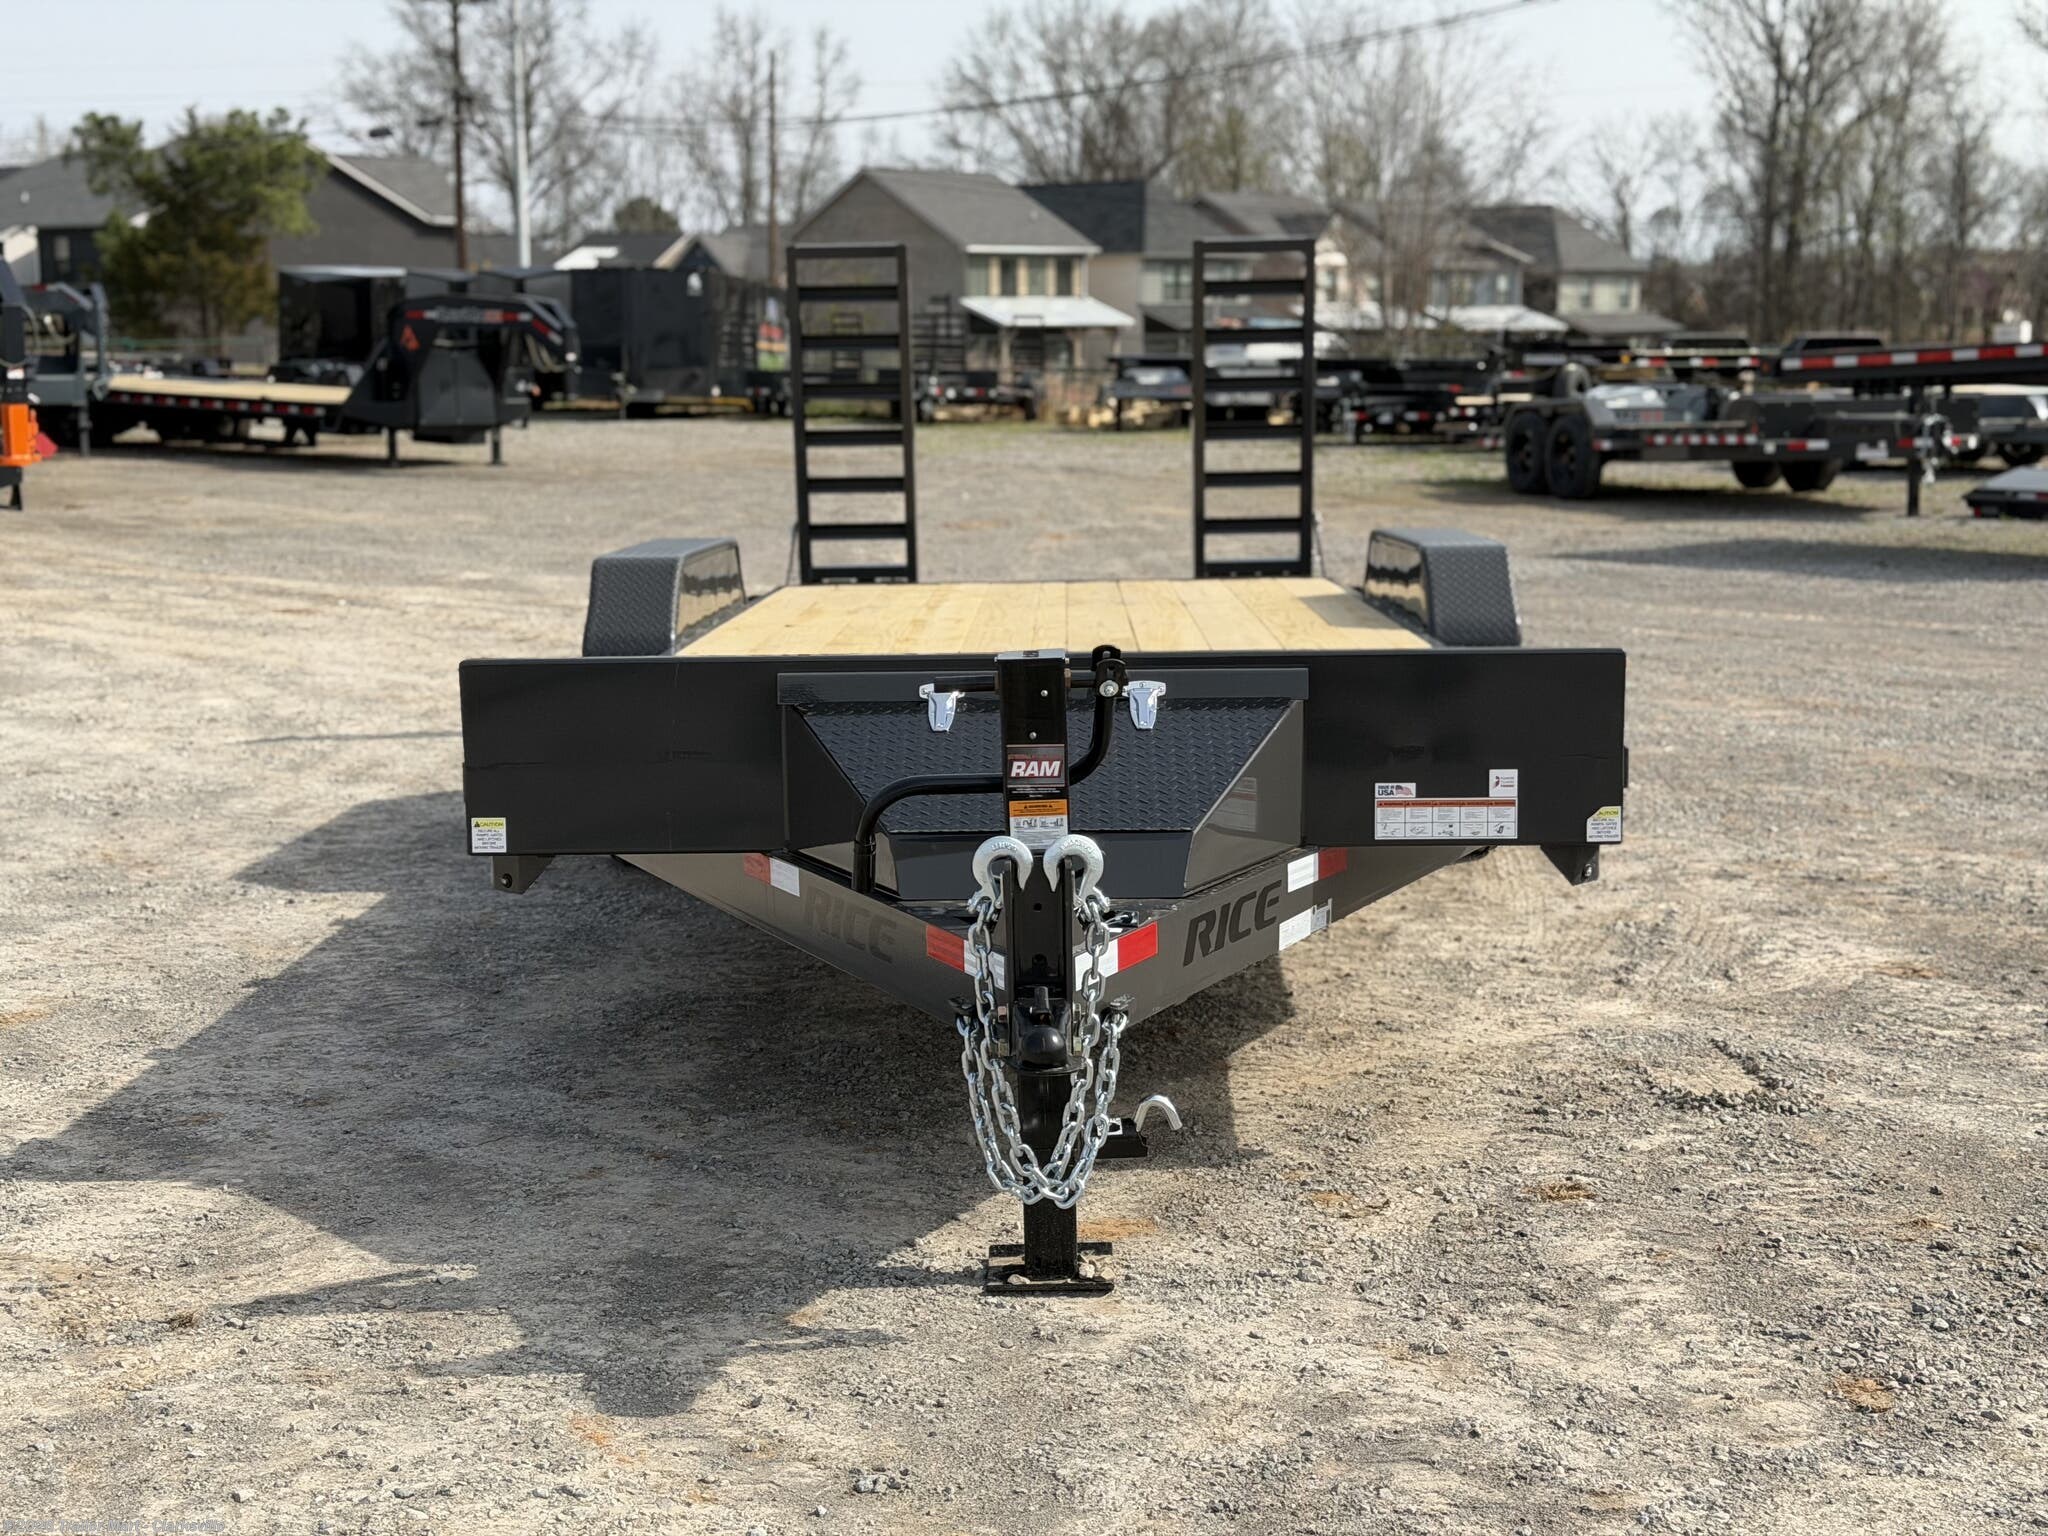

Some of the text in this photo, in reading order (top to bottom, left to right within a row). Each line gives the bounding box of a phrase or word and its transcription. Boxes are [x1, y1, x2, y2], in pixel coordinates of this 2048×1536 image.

[1011, 761, 1060, 777] RAM
[804, 886, 898, 964] RICE
[1183, 880, 1282, 967] RICE
